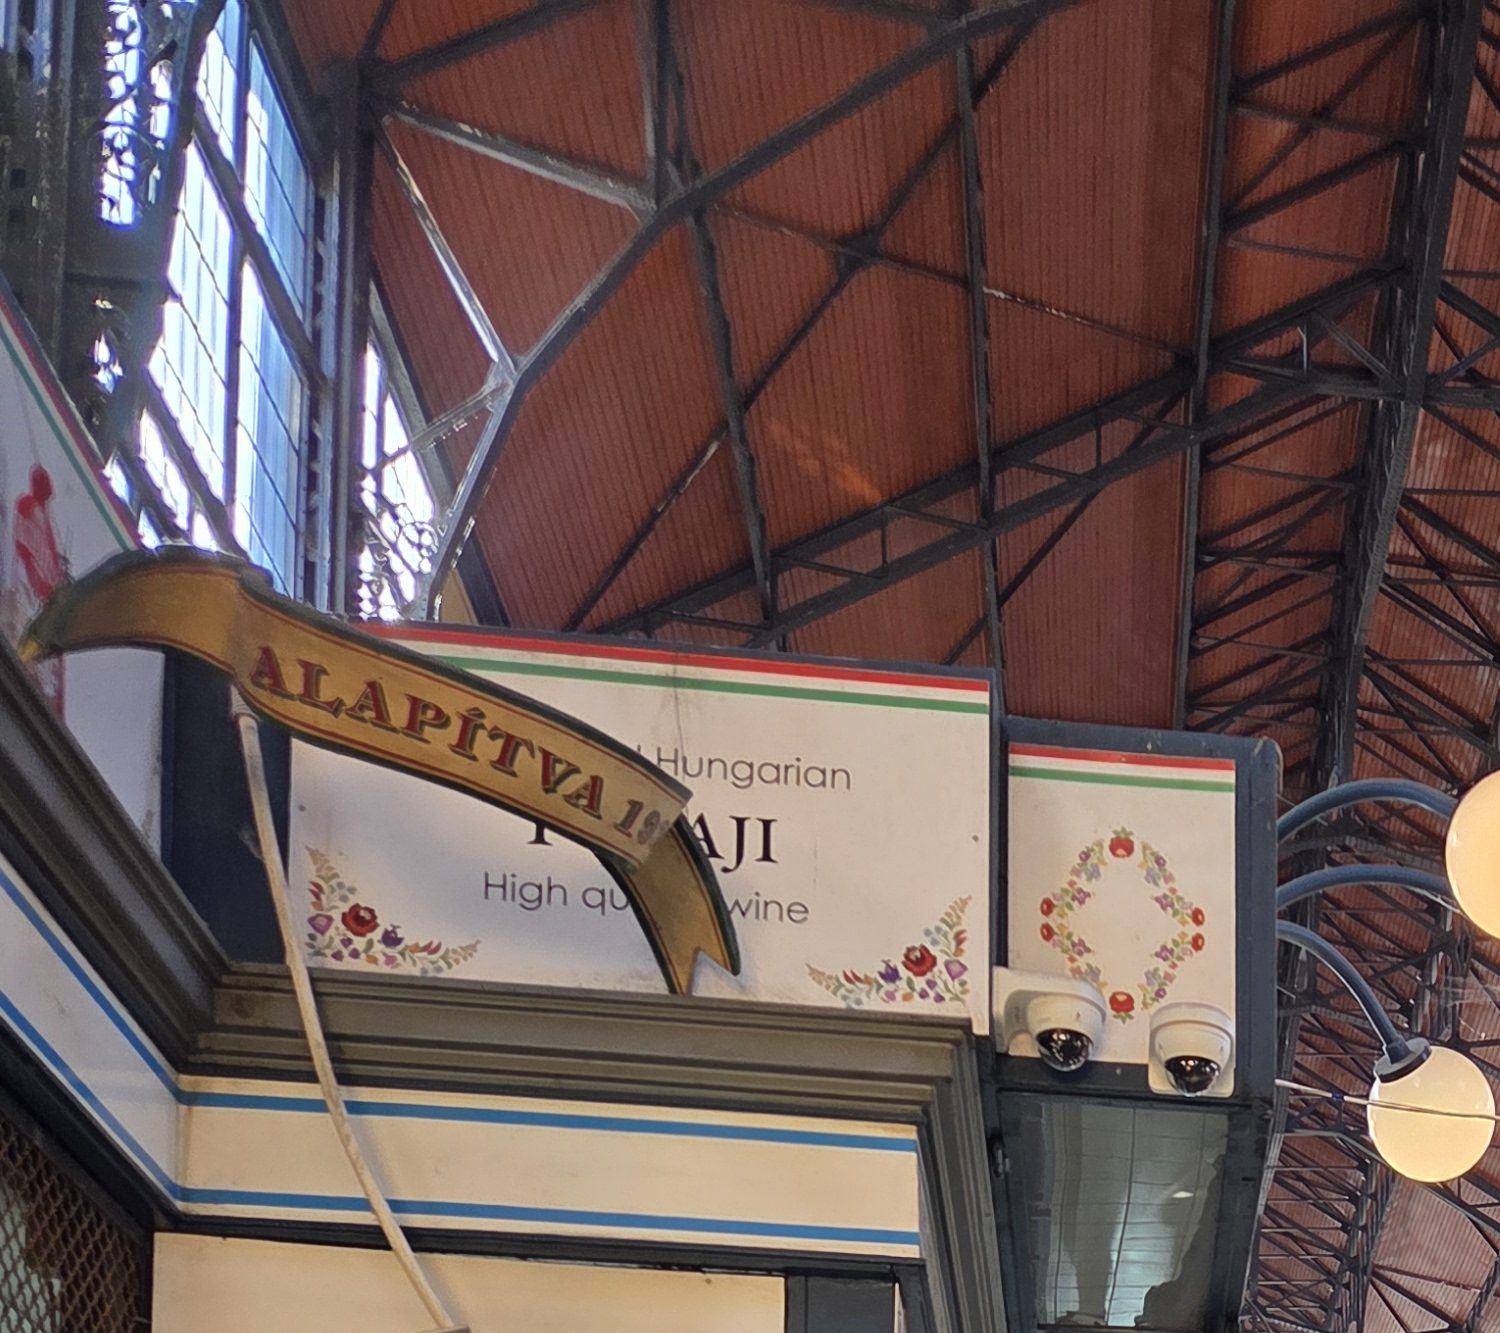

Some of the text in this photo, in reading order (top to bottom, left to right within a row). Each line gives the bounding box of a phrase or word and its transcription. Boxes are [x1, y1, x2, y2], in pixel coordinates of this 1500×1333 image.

[248, 644, 605, 821] ALAPÍTVA
[656, 746, 851, 790] Hungarian
[484, 871, 568, 911] High
[727, 891, 810, 924] wine
